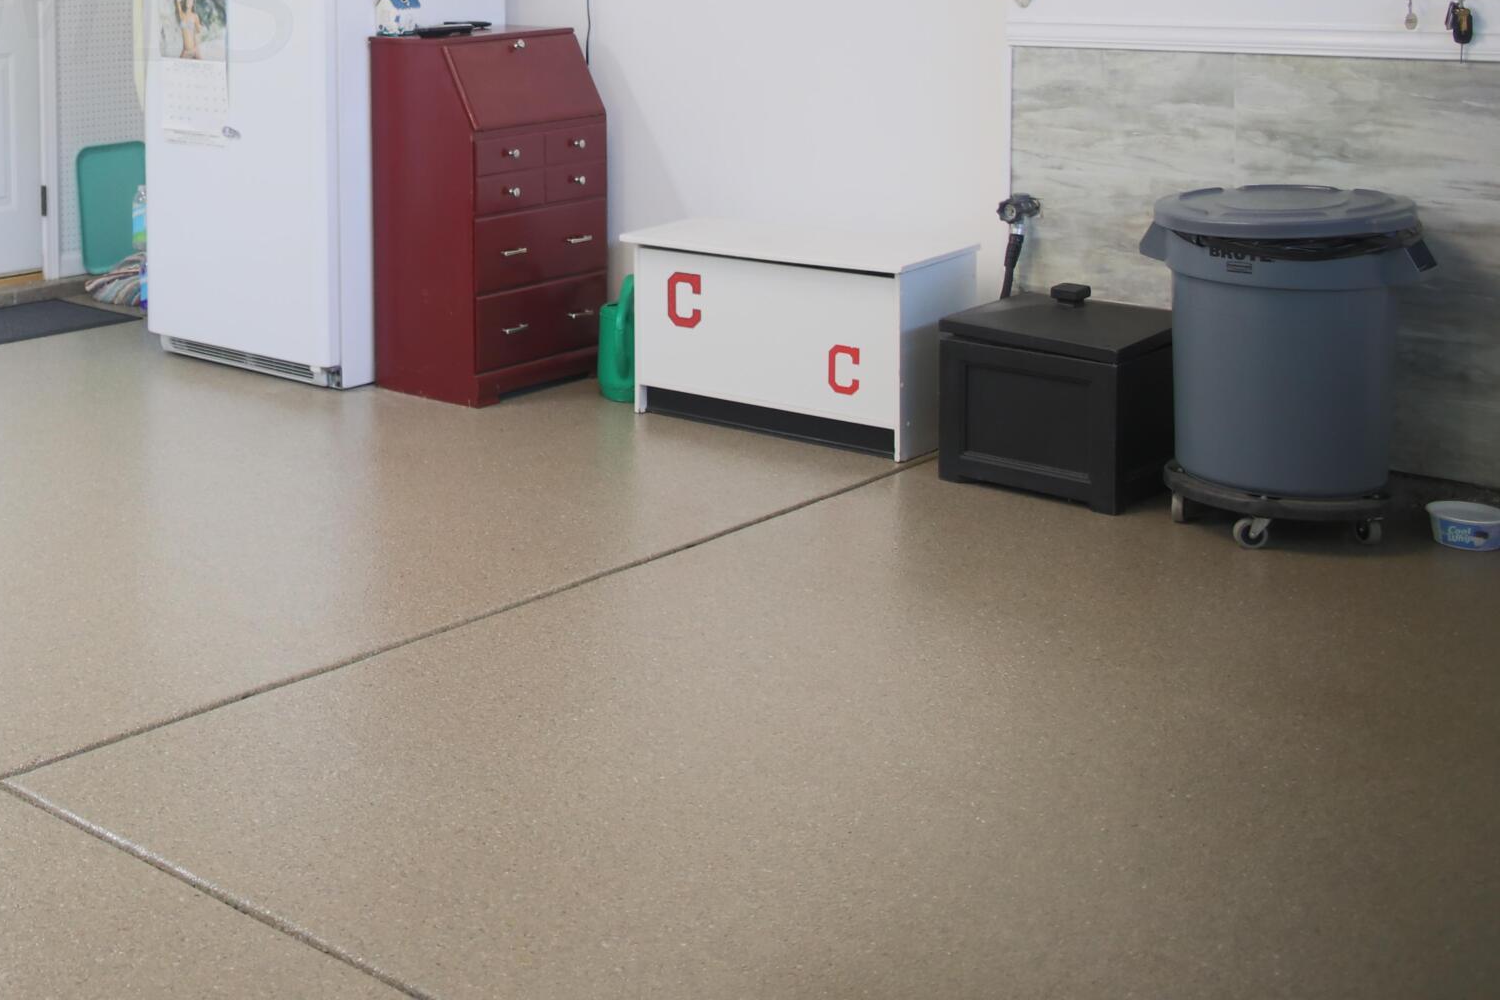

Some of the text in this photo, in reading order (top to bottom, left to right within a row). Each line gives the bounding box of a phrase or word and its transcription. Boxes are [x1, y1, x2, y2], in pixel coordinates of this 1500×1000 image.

[667, 271, 702, 329] C
[828, 344, 860, 396] C
[1448, 526, 1472, 536] Cool
